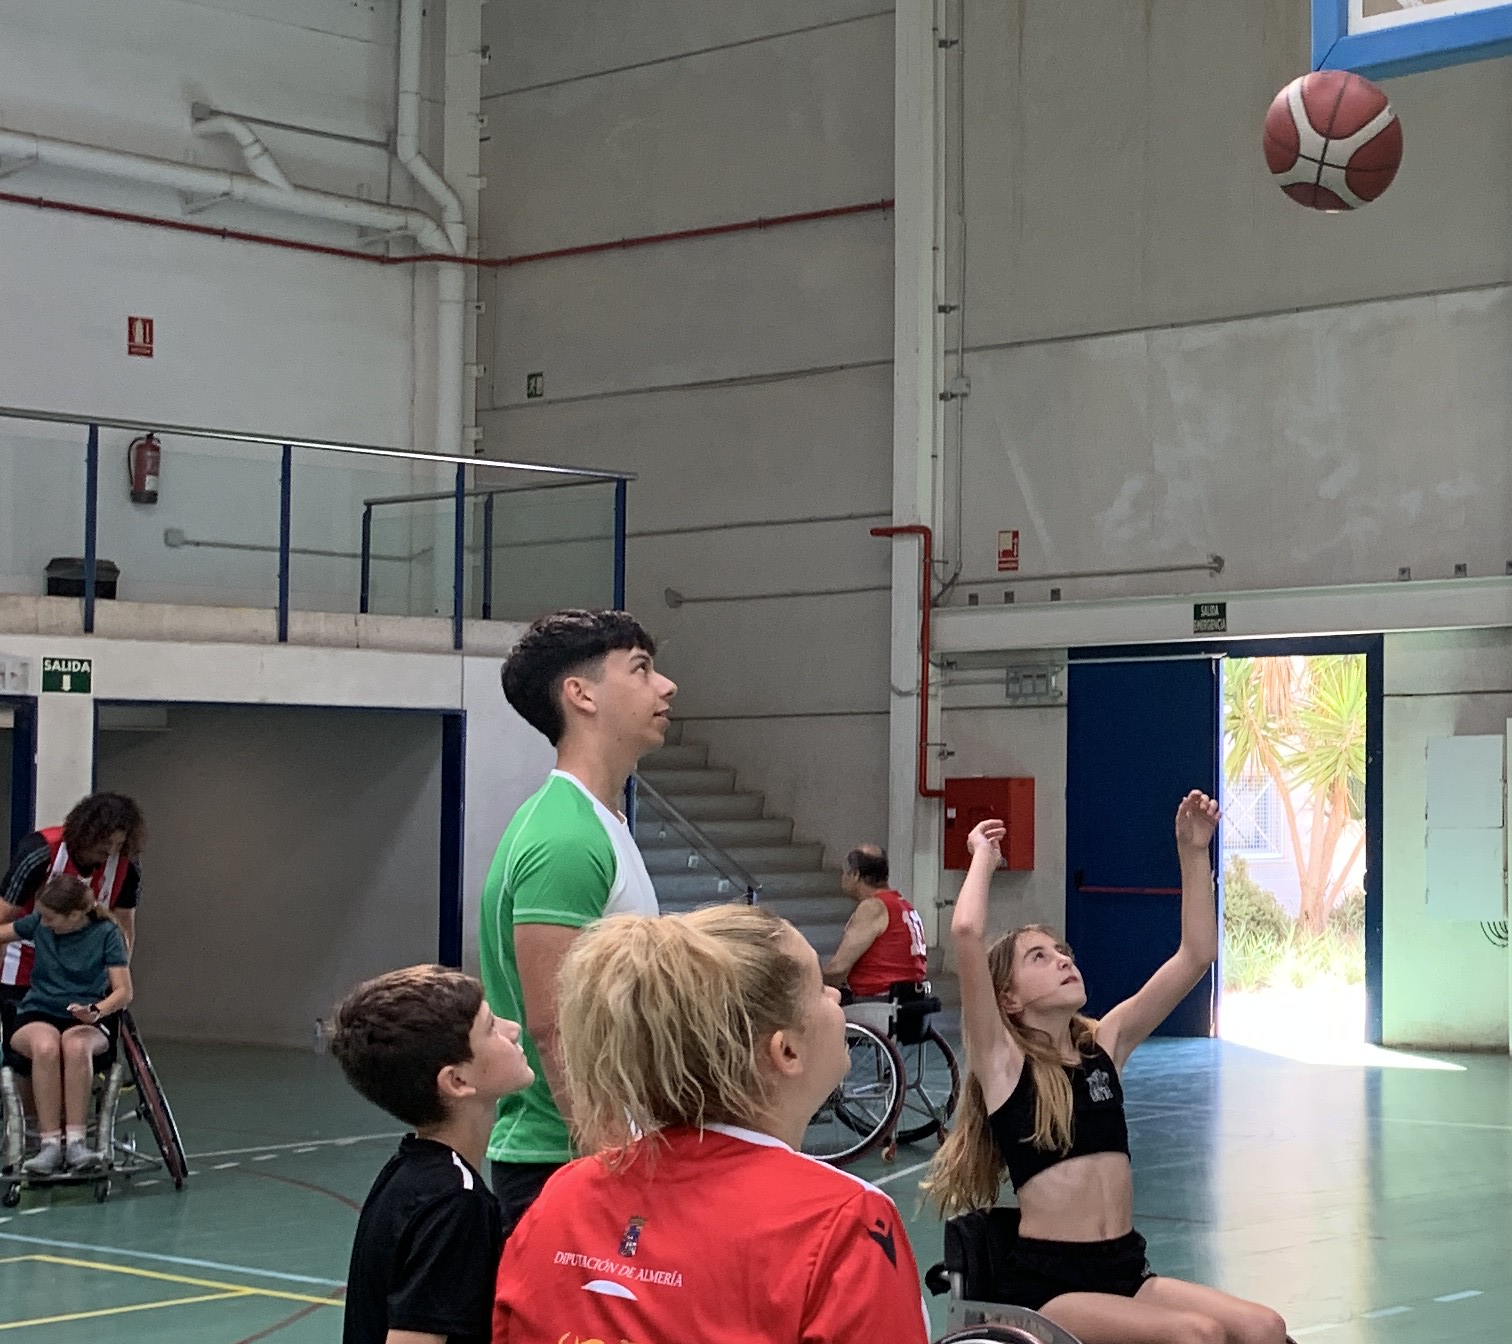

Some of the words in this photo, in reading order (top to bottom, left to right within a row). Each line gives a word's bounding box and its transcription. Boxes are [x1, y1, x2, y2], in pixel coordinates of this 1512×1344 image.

[44, 659, 91, 673] SALIDA
[554, 1251, 620, 1274] DIPUTACIÓN
[618, 1265, 636, 1279] DE
[635, 1269, 683, 1288] ALMERÍA
